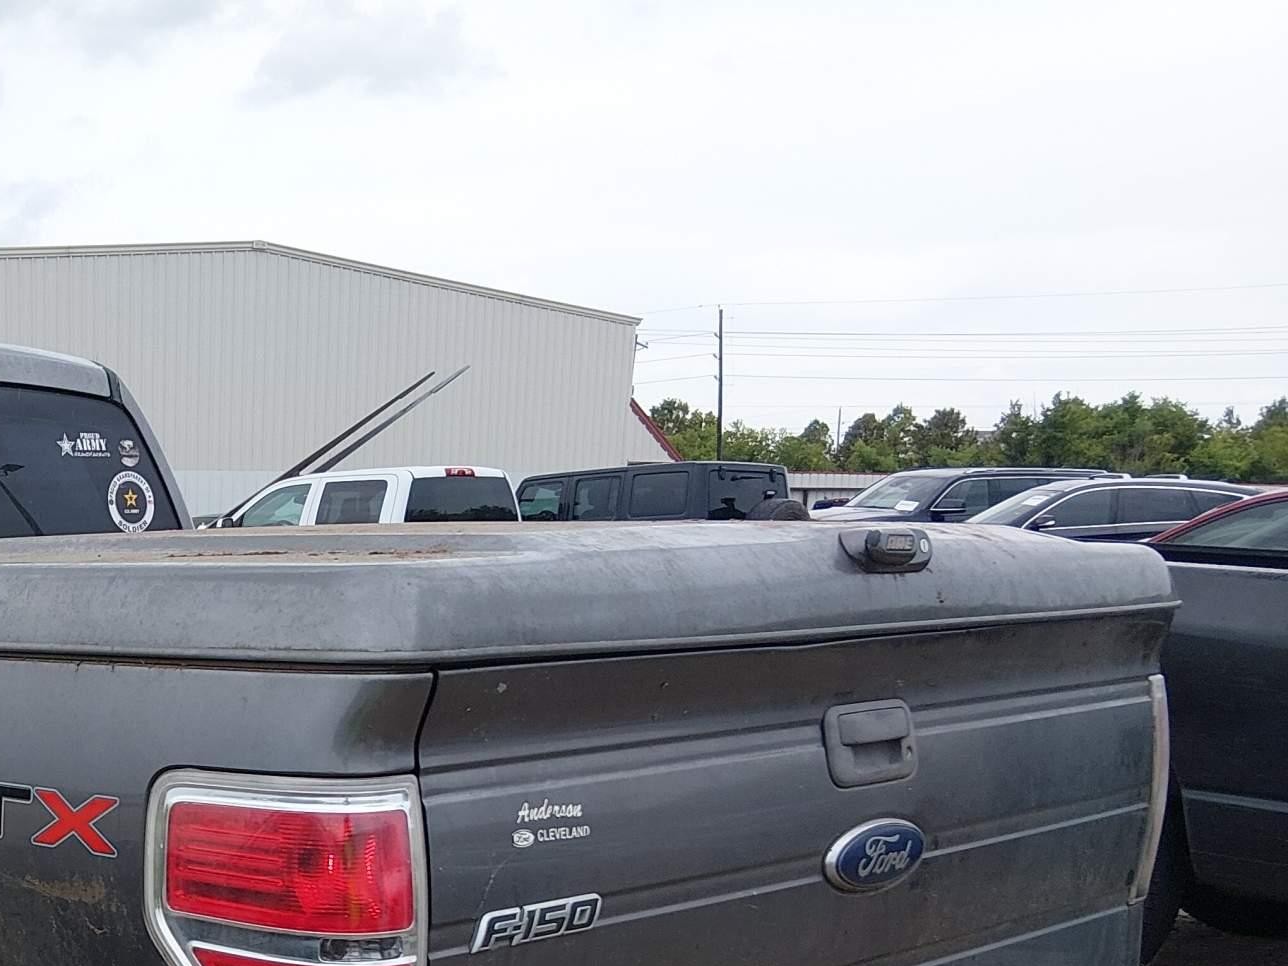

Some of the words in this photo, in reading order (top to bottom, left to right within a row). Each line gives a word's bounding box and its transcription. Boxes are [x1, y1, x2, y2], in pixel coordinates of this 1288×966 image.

[75, 438, 107, 451] ARMY
[118, 520, 148, 533] SOLDIER
[517, 798, 584, 824] Anderson
[537, 825, 591, 842] CLEVELAND
[858, 834, 912, 878] Ford
[471, 893, 603, 954] F-150
